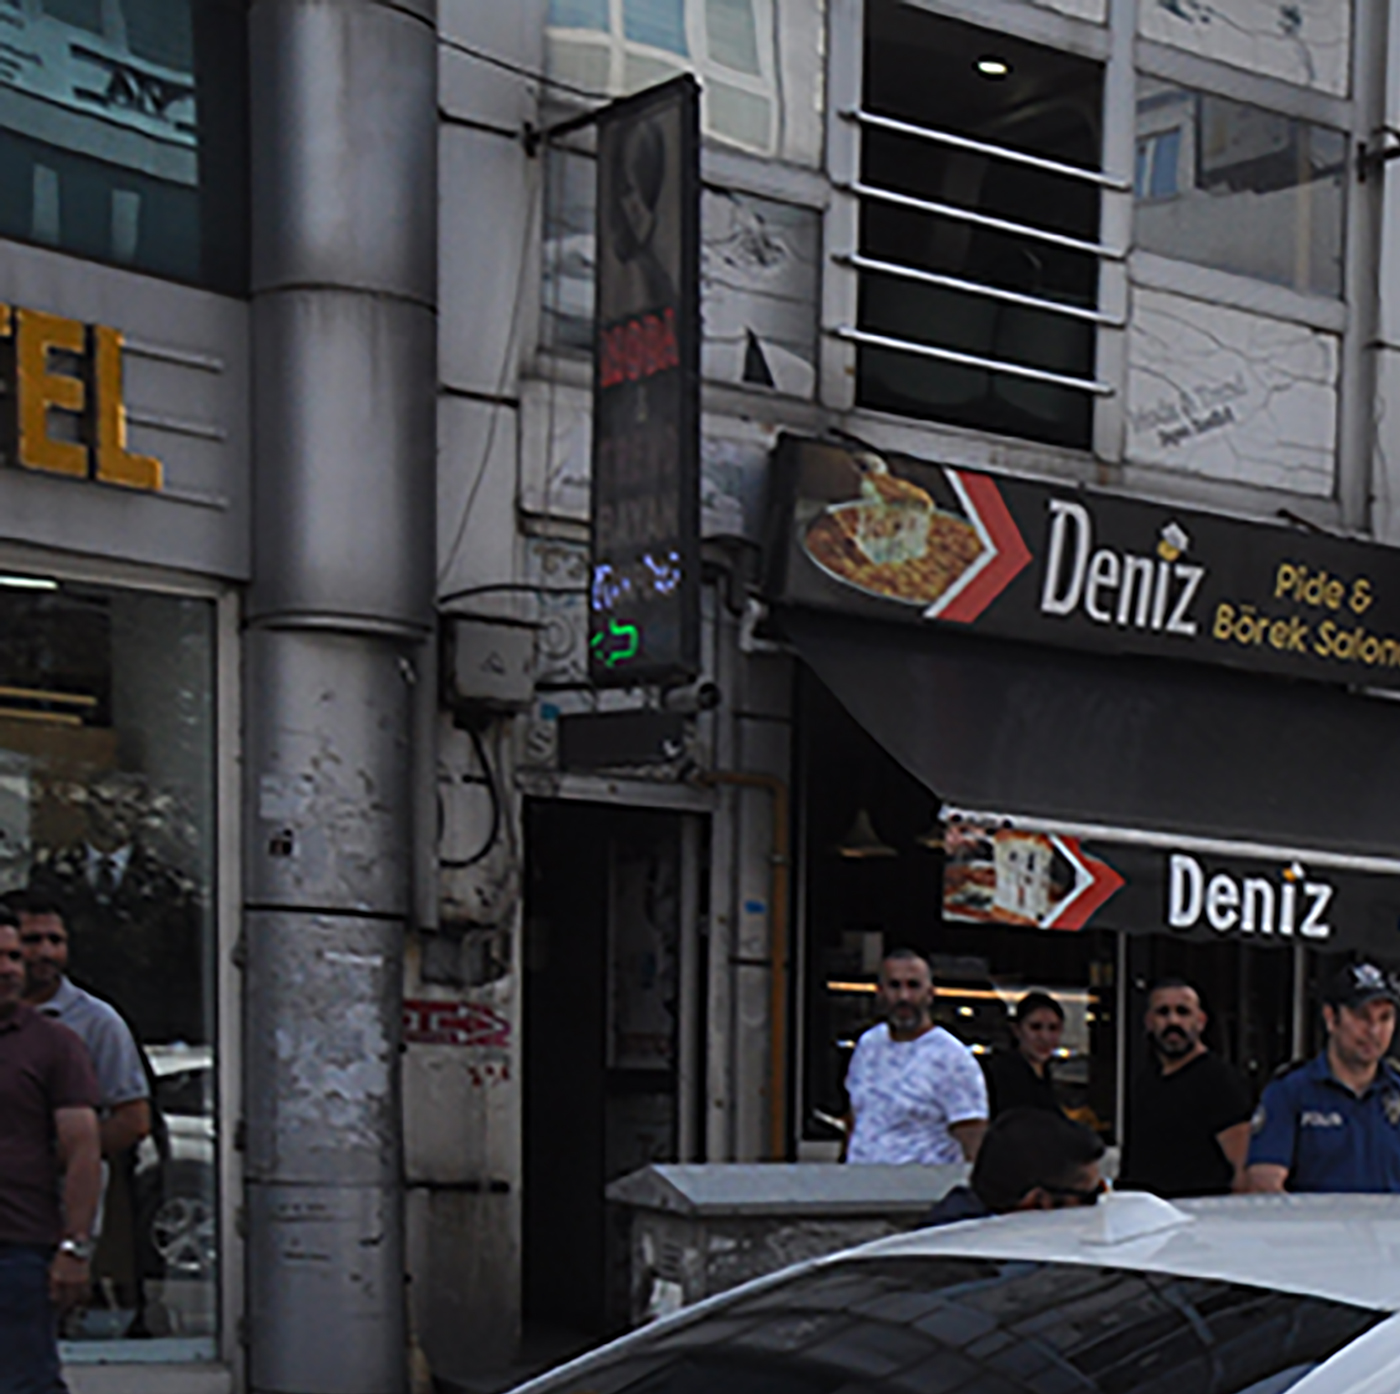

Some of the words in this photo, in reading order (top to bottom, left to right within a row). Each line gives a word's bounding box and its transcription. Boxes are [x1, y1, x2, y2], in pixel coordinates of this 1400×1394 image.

[0, 302, 163, 492] EL
[1041, 498, 1206, 635] Deniz
[1274, 563, 1346, 609] Pide
[1348, 577, 1373, 613] &
[1212, 603, 1308, 653] Börek
[1168, 853, 1333, 939] Deniz
